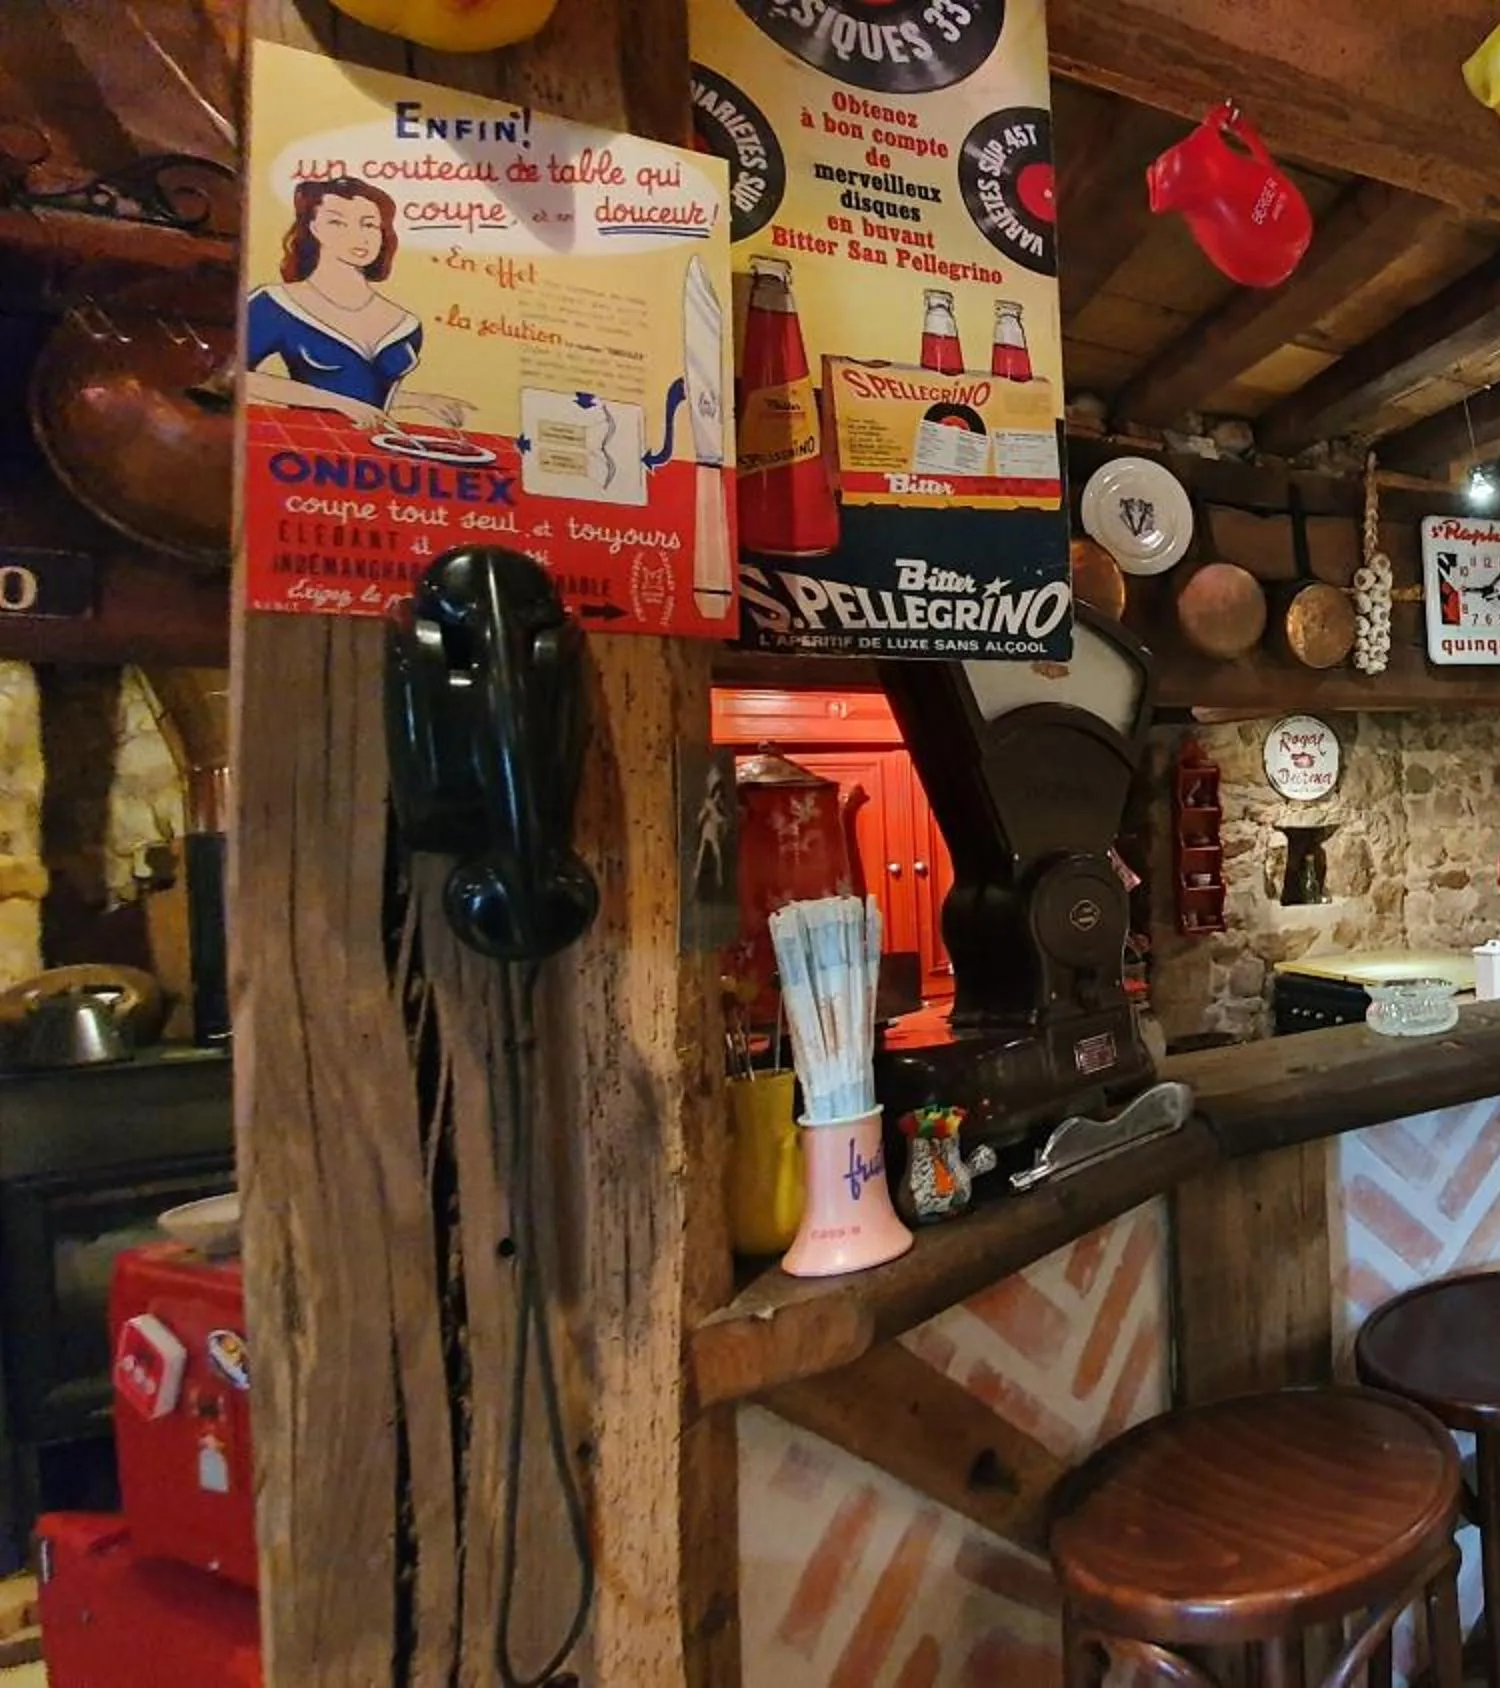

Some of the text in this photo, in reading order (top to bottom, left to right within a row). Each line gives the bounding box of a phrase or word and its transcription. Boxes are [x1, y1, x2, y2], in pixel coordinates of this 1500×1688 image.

[831, 92, 919, 129] Obtenez
[800, 106, 950, 160] à bon compte
[289, 148, 682, 198] un couteau de table qui
[865, 147, 892, 169] de
[814, 163, 943, 203] merveilleux
[840, 191, 922, 222] disques
[976, 178, 1044, 257] VARIETES
[827, 214, 935, 250] en buvant
[771, 224, 1003, 286] Bitter San Pellegrino
[477, 313, 563, 346] solution
[268, 450, 520, 506] ONDULEX
[884, 473, 955, 498] Bitter
[285, 495, 379, 525] coupe
[386, 500, 450, 527] tout
[459, 511, 519, 533] seul
[567, 515, 682, 555] toujours
[894, 557, 977, 595] Bitter
[739, 562, 1073, 639] S.PELLEGRINO
[858, 636, 882, 650] DE
[887, 638, 930, 651] LUXE
[934, 638, 980, 652] SANS
[984, 640, 1049, 654] ALCOOL
